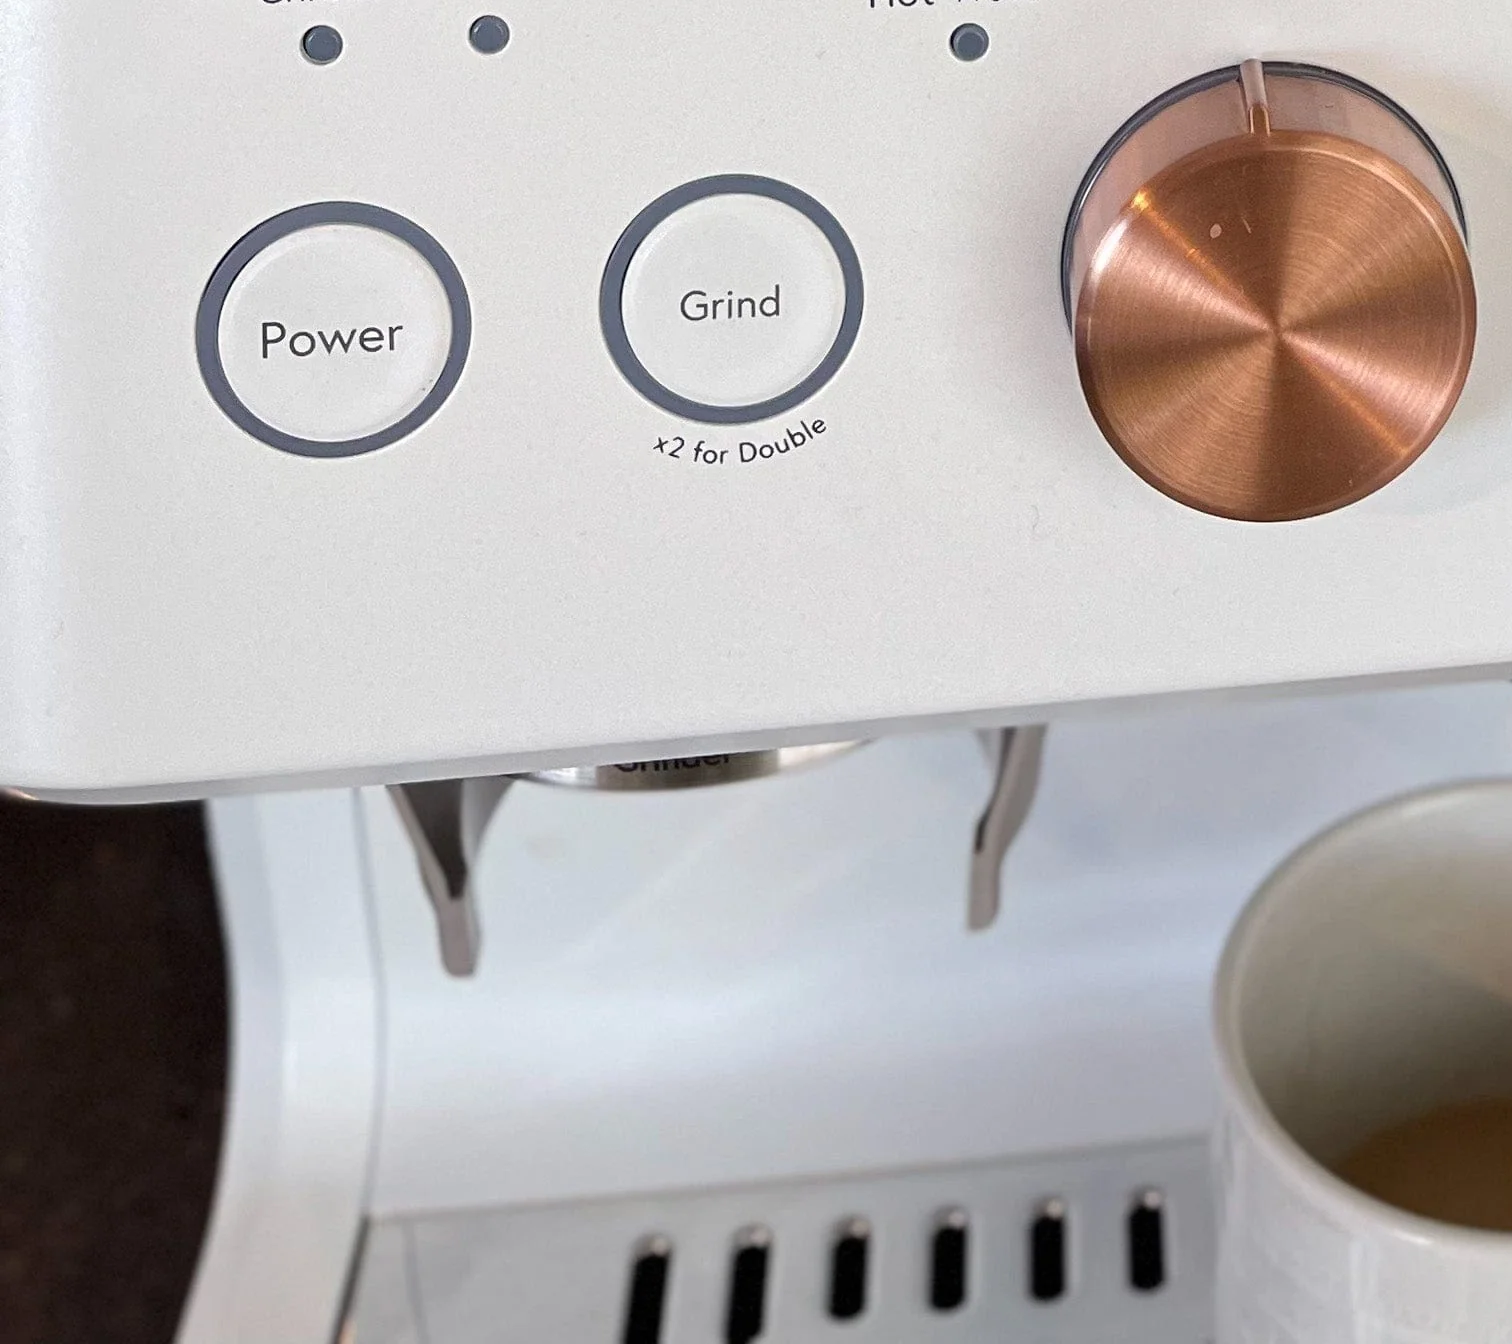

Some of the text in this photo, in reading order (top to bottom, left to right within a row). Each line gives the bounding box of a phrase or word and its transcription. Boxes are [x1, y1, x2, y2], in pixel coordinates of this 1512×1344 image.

[680, 285, 781, 322] Grind
[261, 320, 403, 359] Power
[653, 418, 827, 464] x2 for Double
